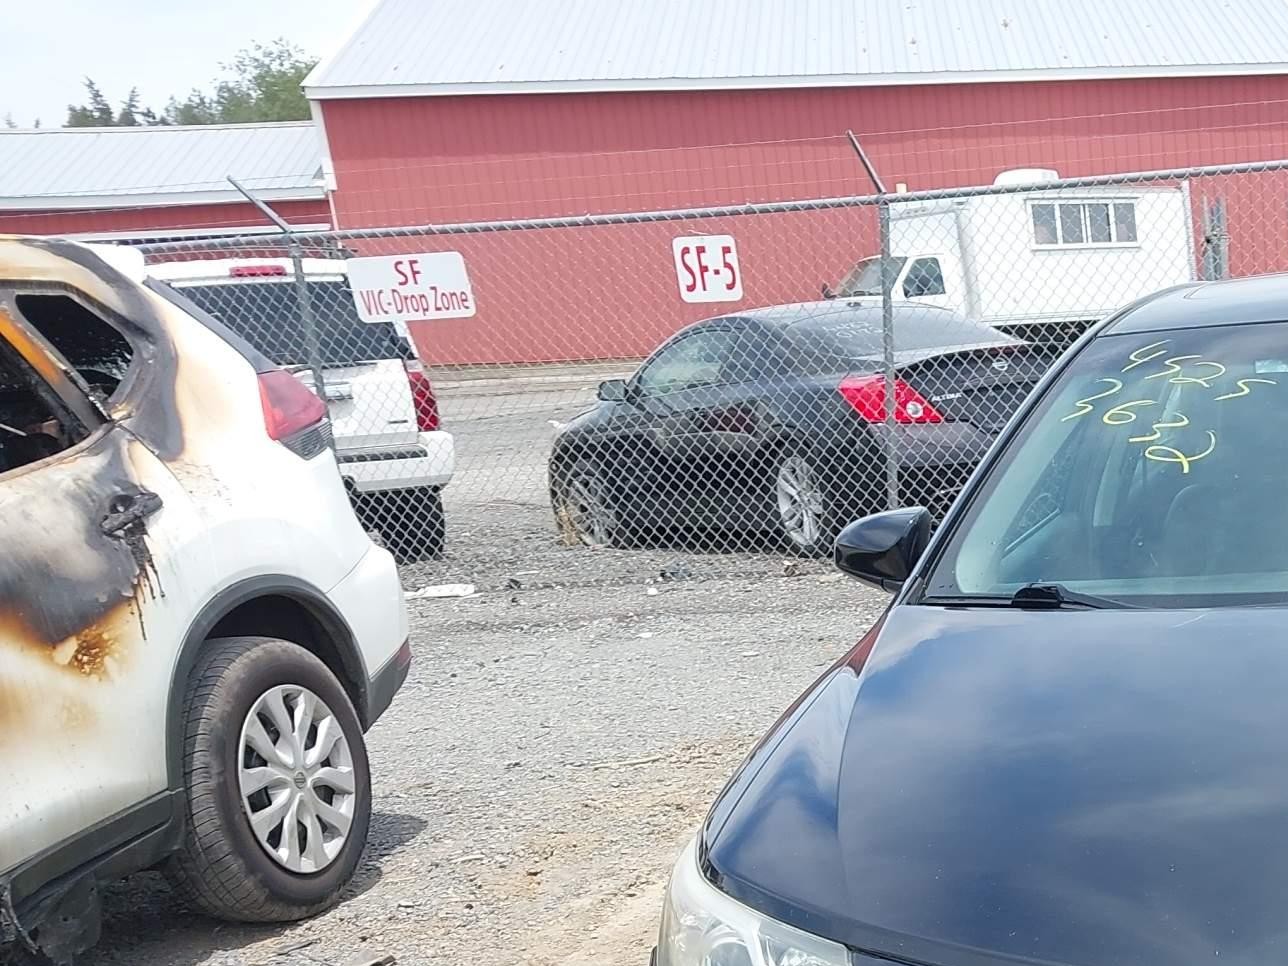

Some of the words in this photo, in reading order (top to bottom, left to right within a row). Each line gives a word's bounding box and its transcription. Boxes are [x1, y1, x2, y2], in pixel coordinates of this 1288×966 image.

[393, 259, 422, 286] SF
[680, 245, 737, 292] SF-5
[359, 288, 429, 317] VIC-Drop
[429, 285, 470, 311] Zone
[1120, 339, 1278, 401] 4525
